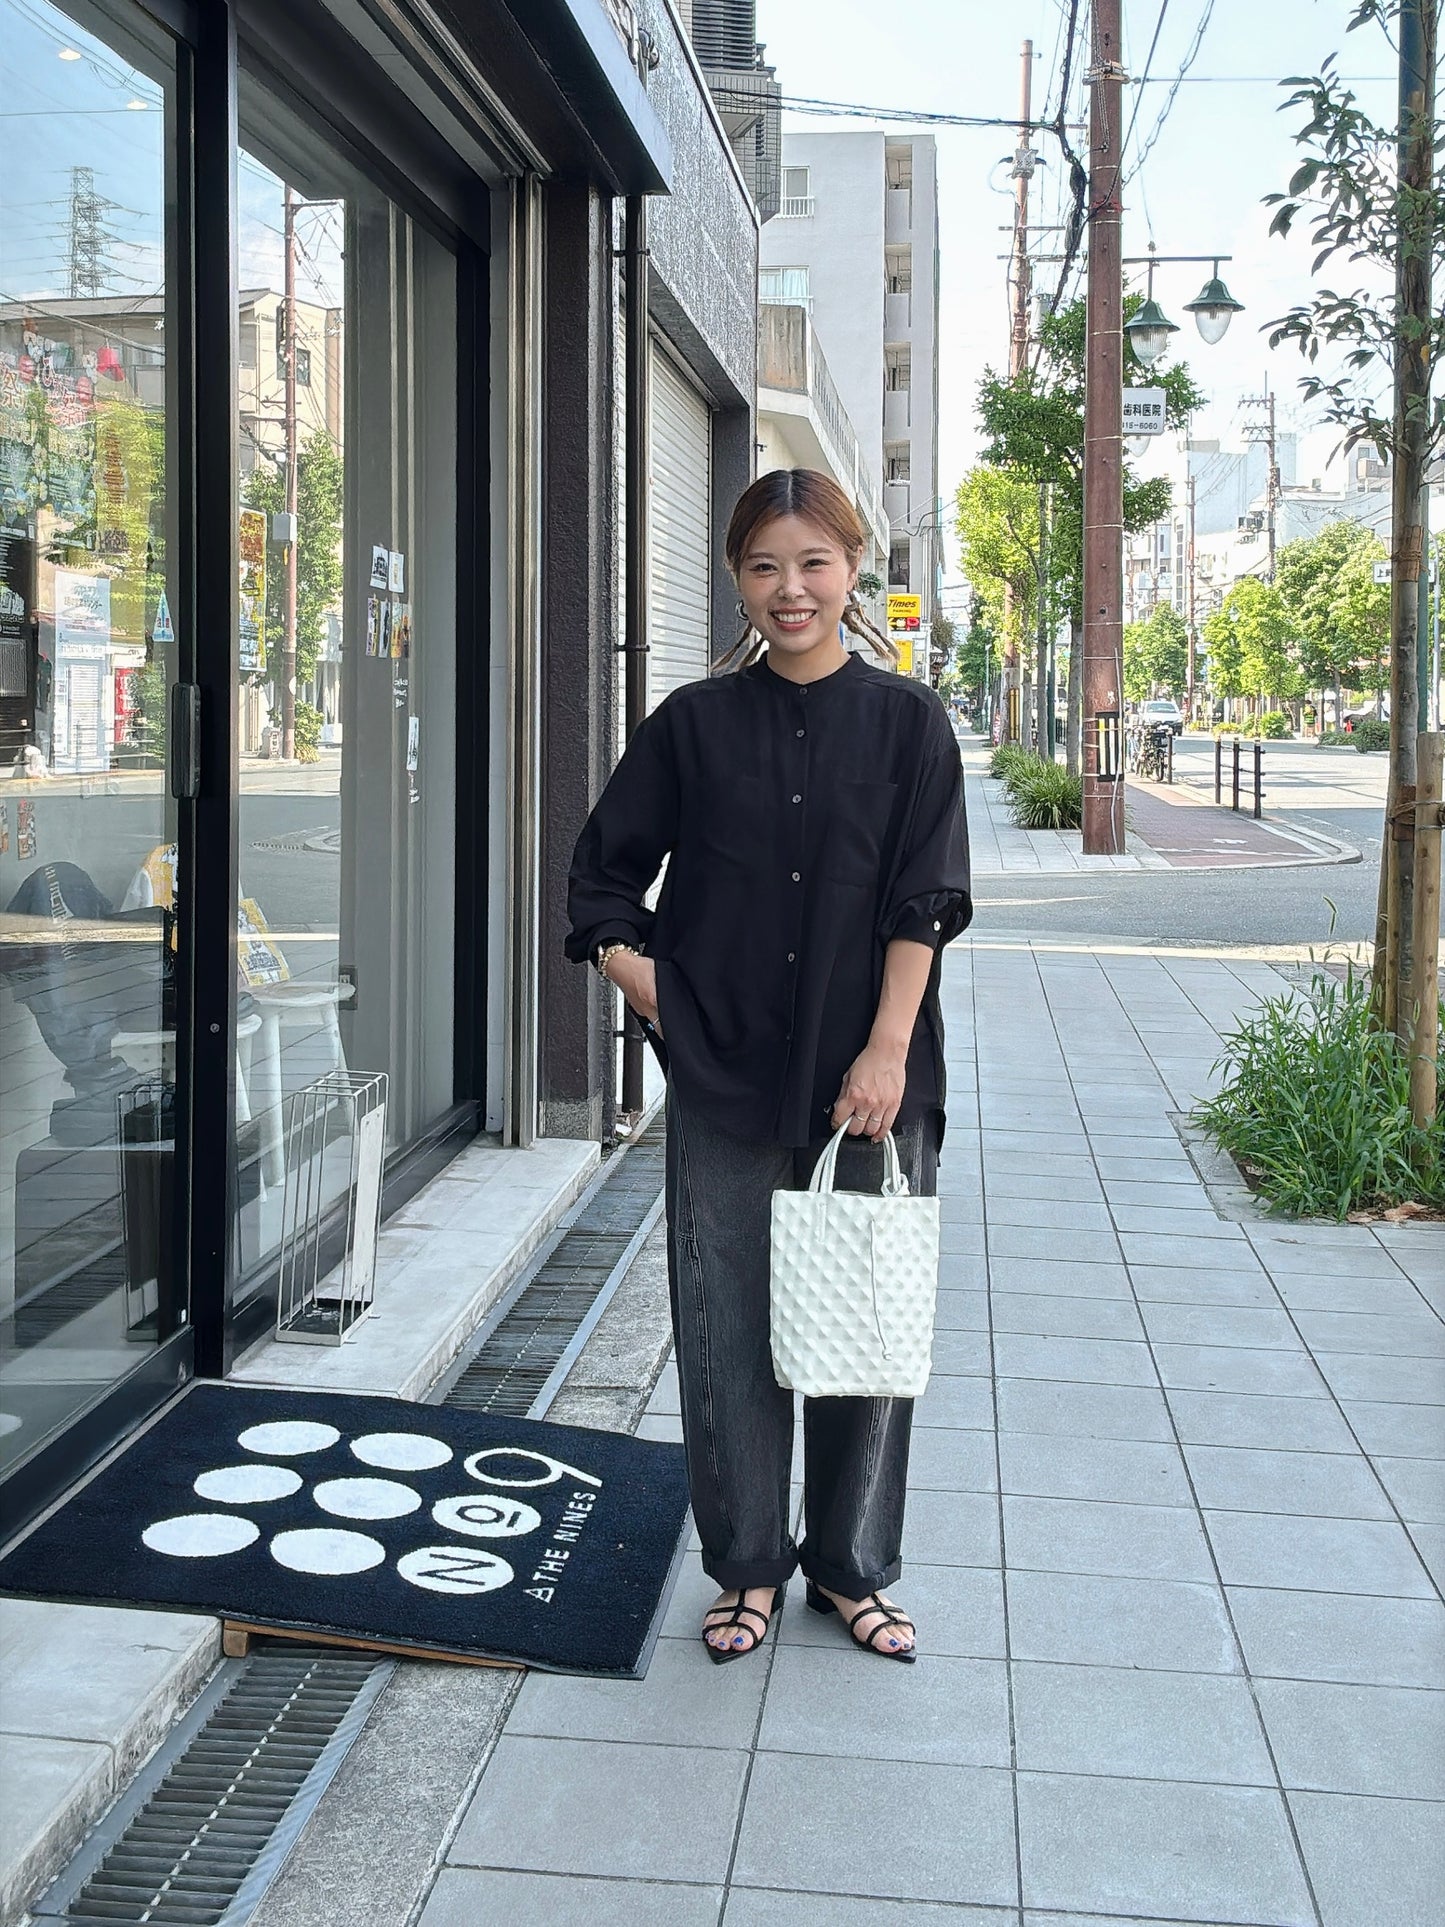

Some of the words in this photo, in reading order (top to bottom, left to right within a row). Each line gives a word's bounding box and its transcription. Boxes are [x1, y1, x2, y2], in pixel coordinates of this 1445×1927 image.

[1123, 402, 1162, 417] 歯科医院
[888, 598, 917, 608] Times
[553, 1492, 597, 1543] NINES
